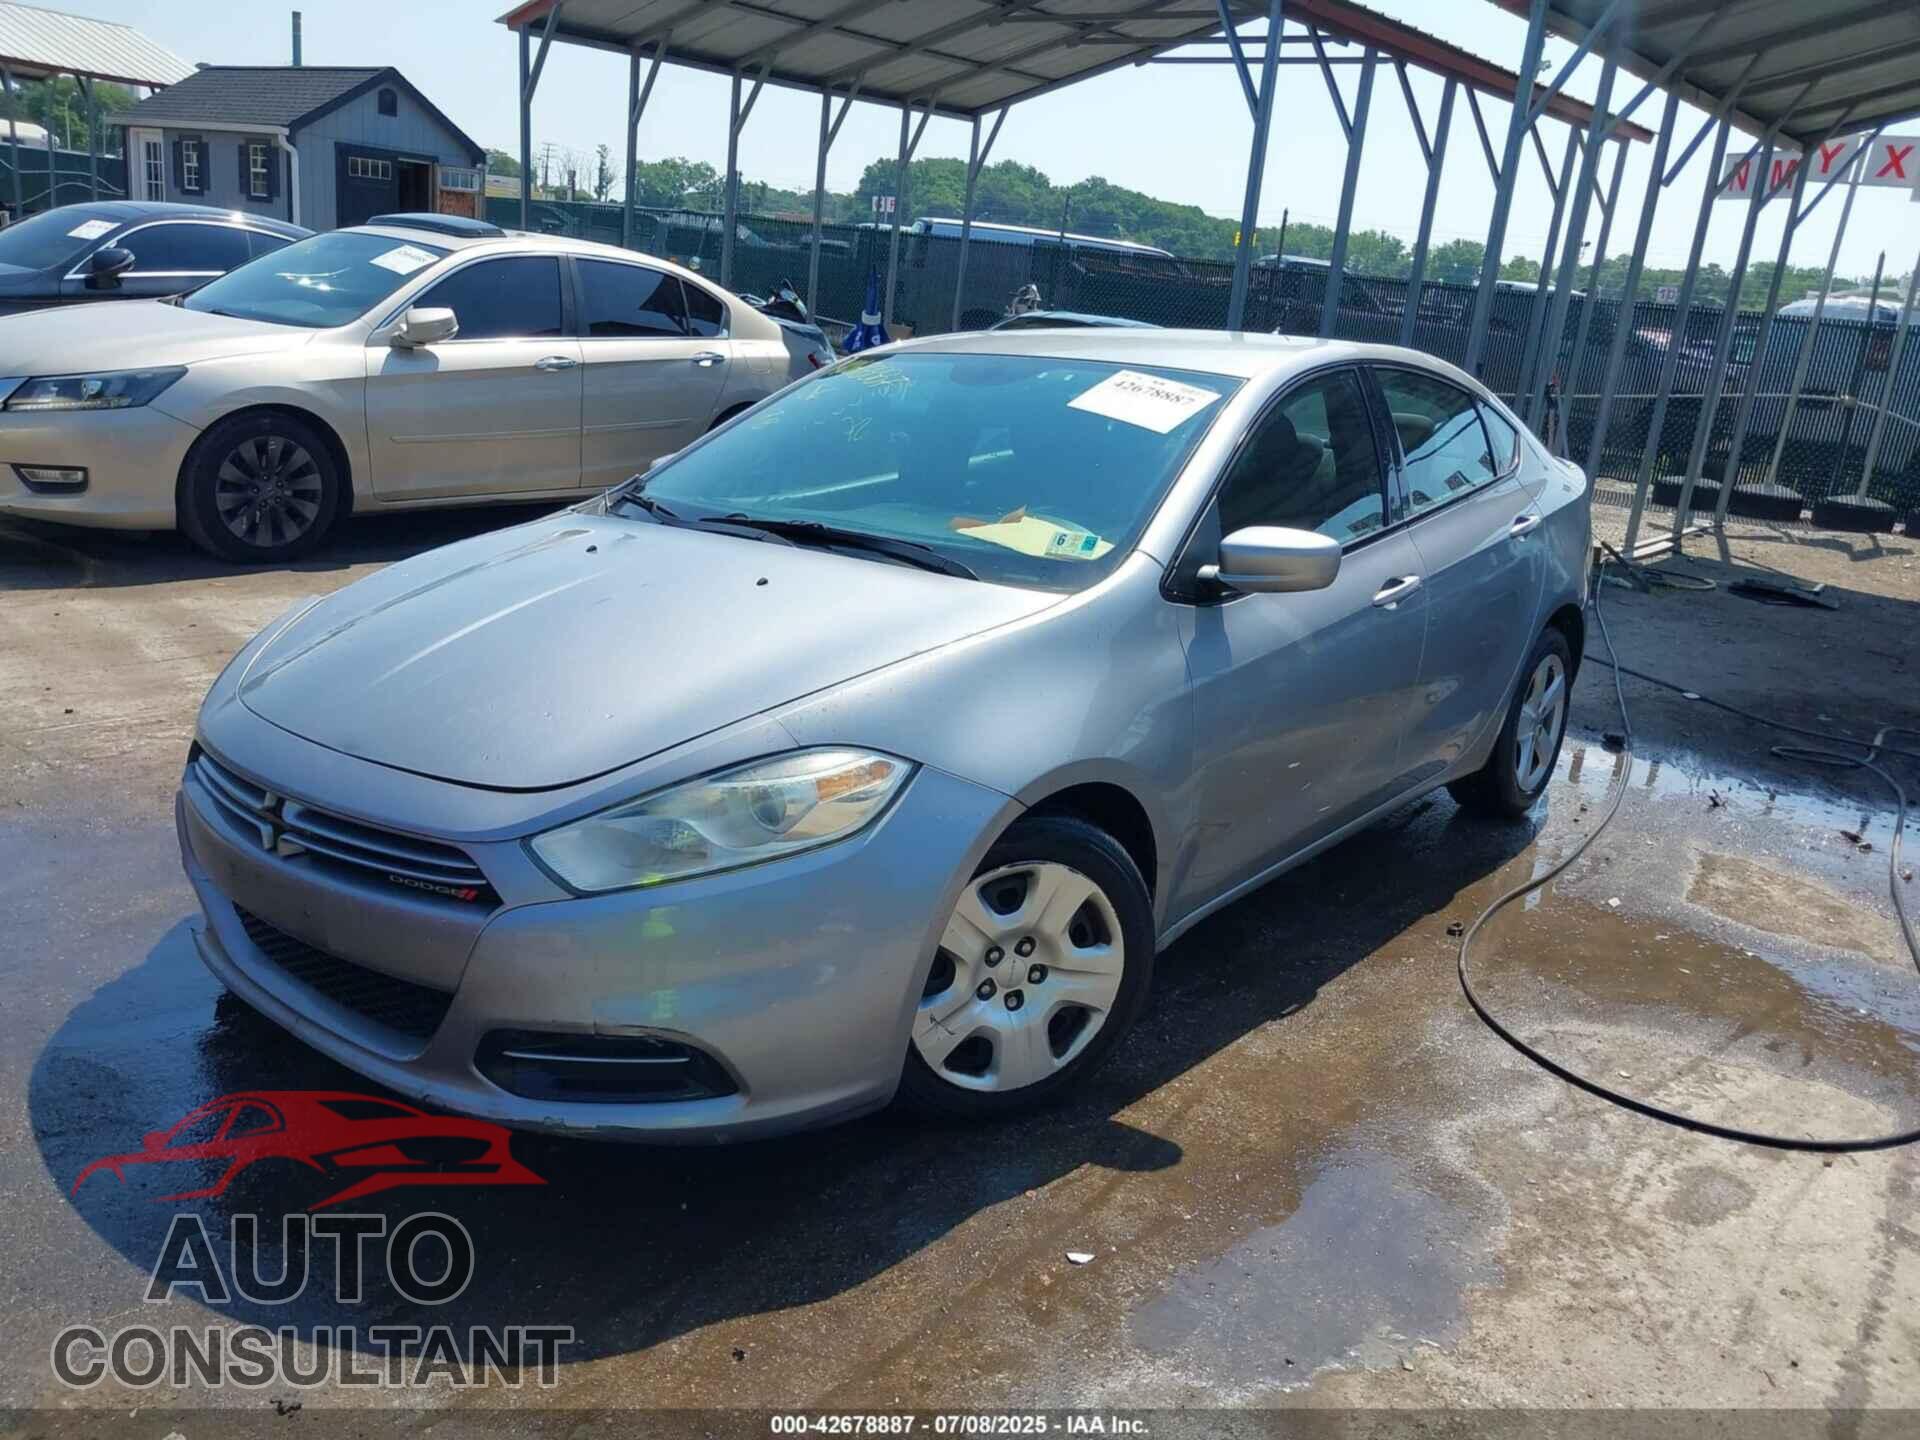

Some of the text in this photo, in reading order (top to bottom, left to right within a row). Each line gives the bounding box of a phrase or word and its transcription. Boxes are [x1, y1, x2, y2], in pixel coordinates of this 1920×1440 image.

[1817, 142, 1846, 174] Y
[1873, 143, 1915, 178] X
[1769, 159, 1801, 192] M
[1113, 380, 1196, 405] 42678887
[389, 874, 466, 899] DODGE
